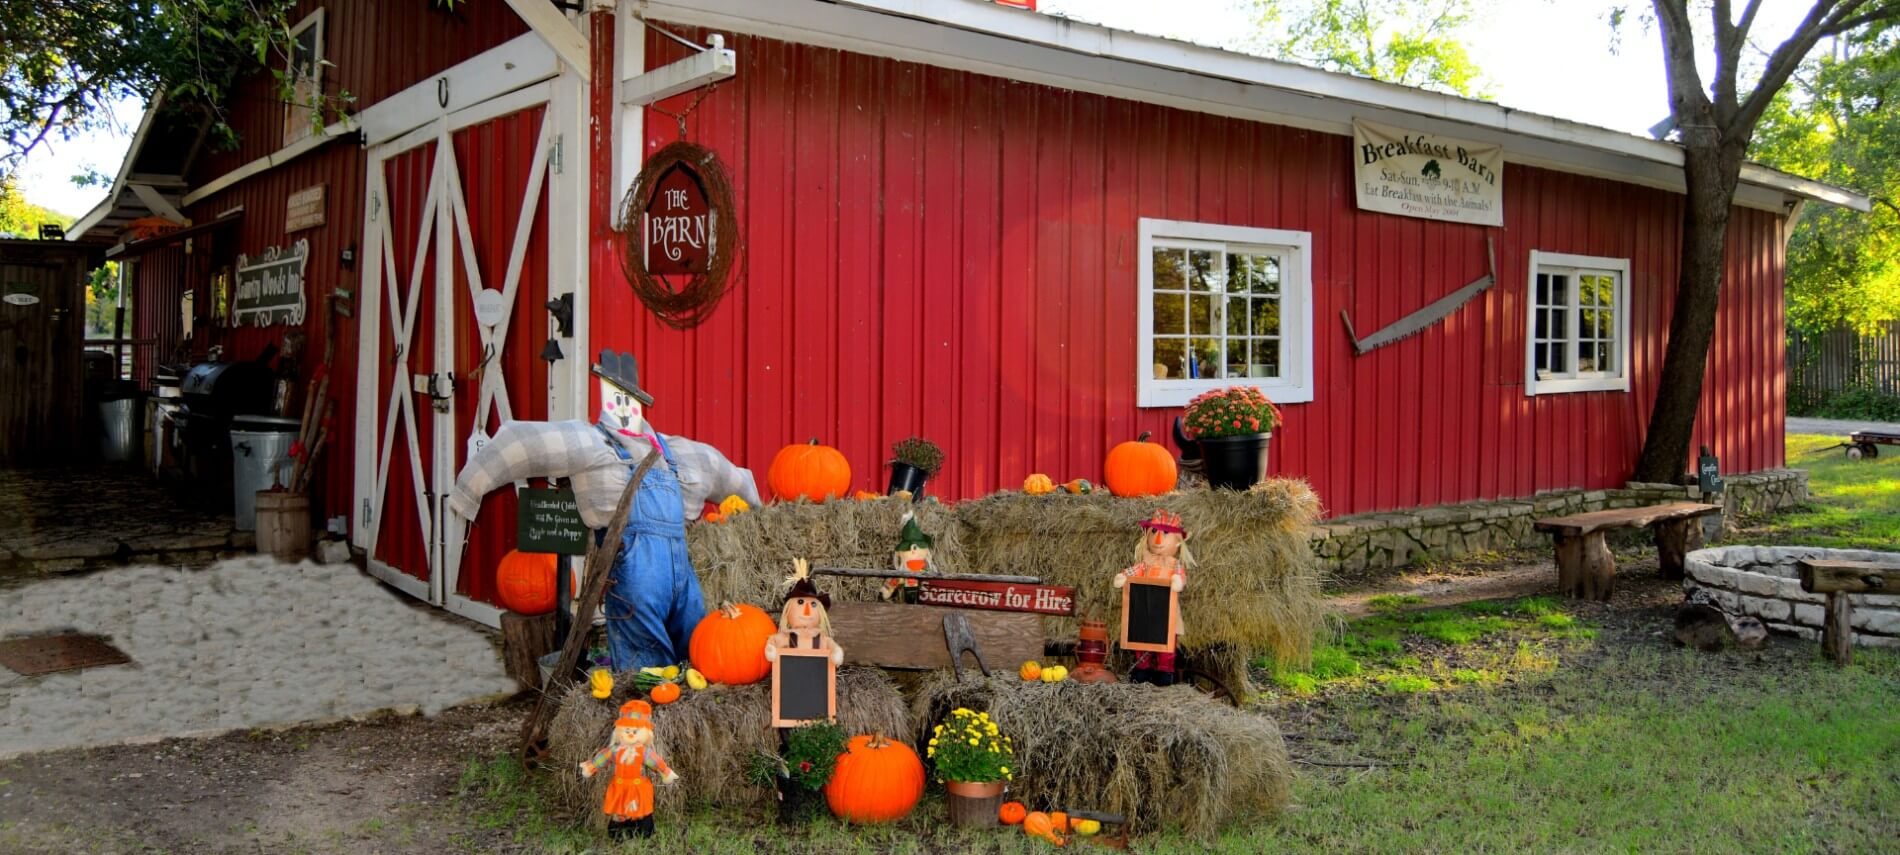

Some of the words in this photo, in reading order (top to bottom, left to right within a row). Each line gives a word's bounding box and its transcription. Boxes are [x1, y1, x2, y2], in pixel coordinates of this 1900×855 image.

[1361, 135, 1453, 165] Breakfast
[1457, 145, 1495, 186] Barn
[664, 188, 690, 211] THE
[1364, 183, 1379, 197] Eat
[1382, 186, 1422, 203] Breakfast
[1425, 192, 1442, 206] with
[1444, 195, 1457, 208] the
[652, 214, 706, 261] BARN
[262, 266, 286, 297] Woods
[287, 265, 299, 295] Inn
[919, 581, 1002, 607] Scarecrow
[1005, 586, 1031, 608] for
[1034, 588, 1072, 611] Hire
